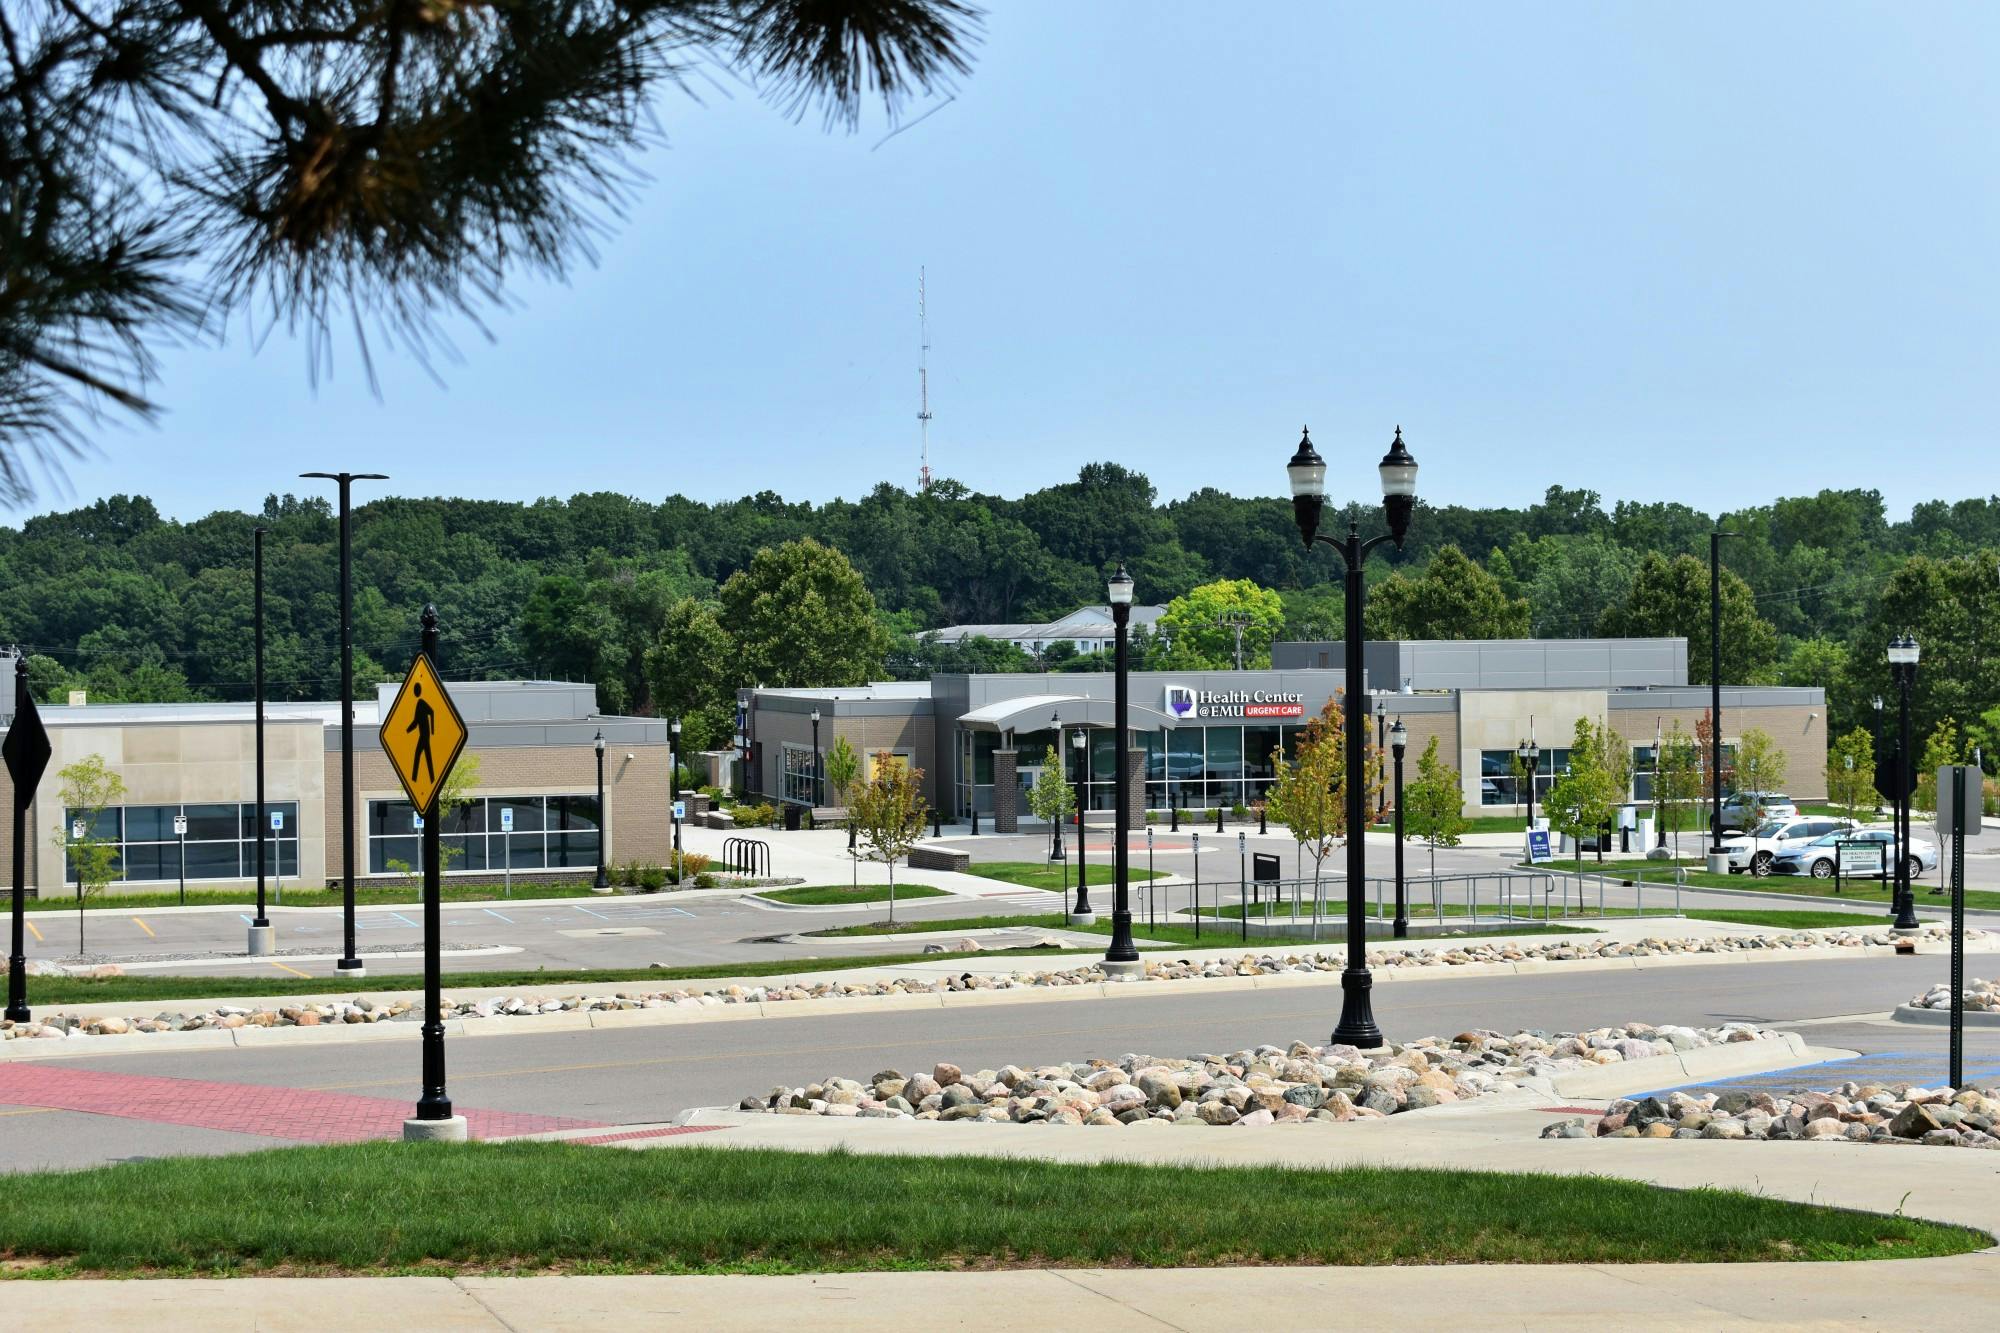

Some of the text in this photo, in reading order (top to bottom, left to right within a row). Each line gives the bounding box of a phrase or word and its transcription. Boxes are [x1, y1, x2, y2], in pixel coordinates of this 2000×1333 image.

[1199, 689, 1303, 704] Health Center
[1247, 706, 1302, 715] URGENT CARE
